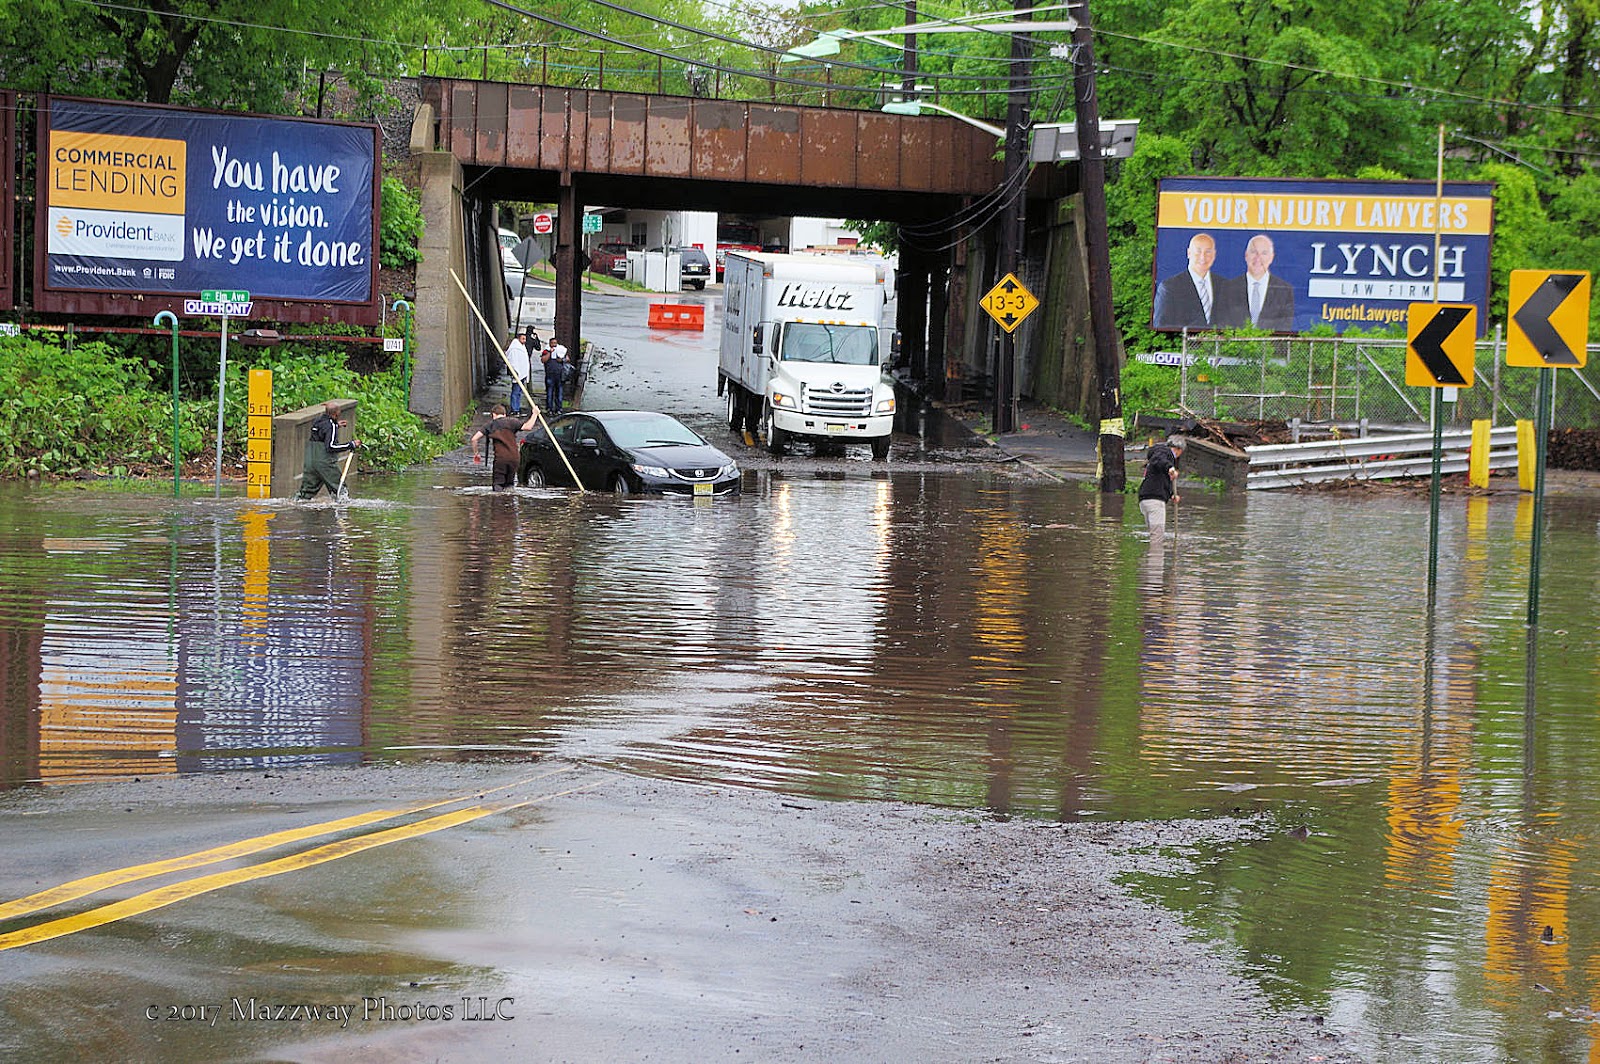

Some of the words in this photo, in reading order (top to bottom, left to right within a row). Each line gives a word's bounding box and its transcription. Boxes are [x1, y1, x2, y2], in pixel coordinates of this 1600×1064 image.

[55, 147, 177, 171] COMMERCIAL
[212, 145, 265, 190] You
[272, 151, 340, 194] have
[56, 167, 177, 198] LENDING
[227, 199, 256, 223] the
[260, 197, 329, 228] vision.
[1184, 197, 1248, 224] YOUR
[1257, 199, 1346, 227] INJURY
[1355, 201, 1468, 229] LAWYERS
[75, 219, 153, 241] Provident
[153, 232, 175, 242] BANK
[193, 227, 226, 259] We
[229, 229, 266, 265] get
[273, 231, 293, 263] it
[298, 230, 364, 267] done.
[1309, 242, 1467, 278] LYNCH
[54, 264, 136, 277] www.Provident.Bank
[231, 291, 246, 301] Ave
[1341, 283, 1373, 295] LAW
[1388, 284, 1431, 297] FIRM
[187, 302, 249, 314] OUTFRONT
[1322, 303, 1409, 324] LynchLawyer
[386, 340, 401, 350] 0741
[249, 403, 255, 414] 5
[249, 426, 255, 437] 4
[249, 450, 255, 460] 3
[248, 473, 255, 483] 2
